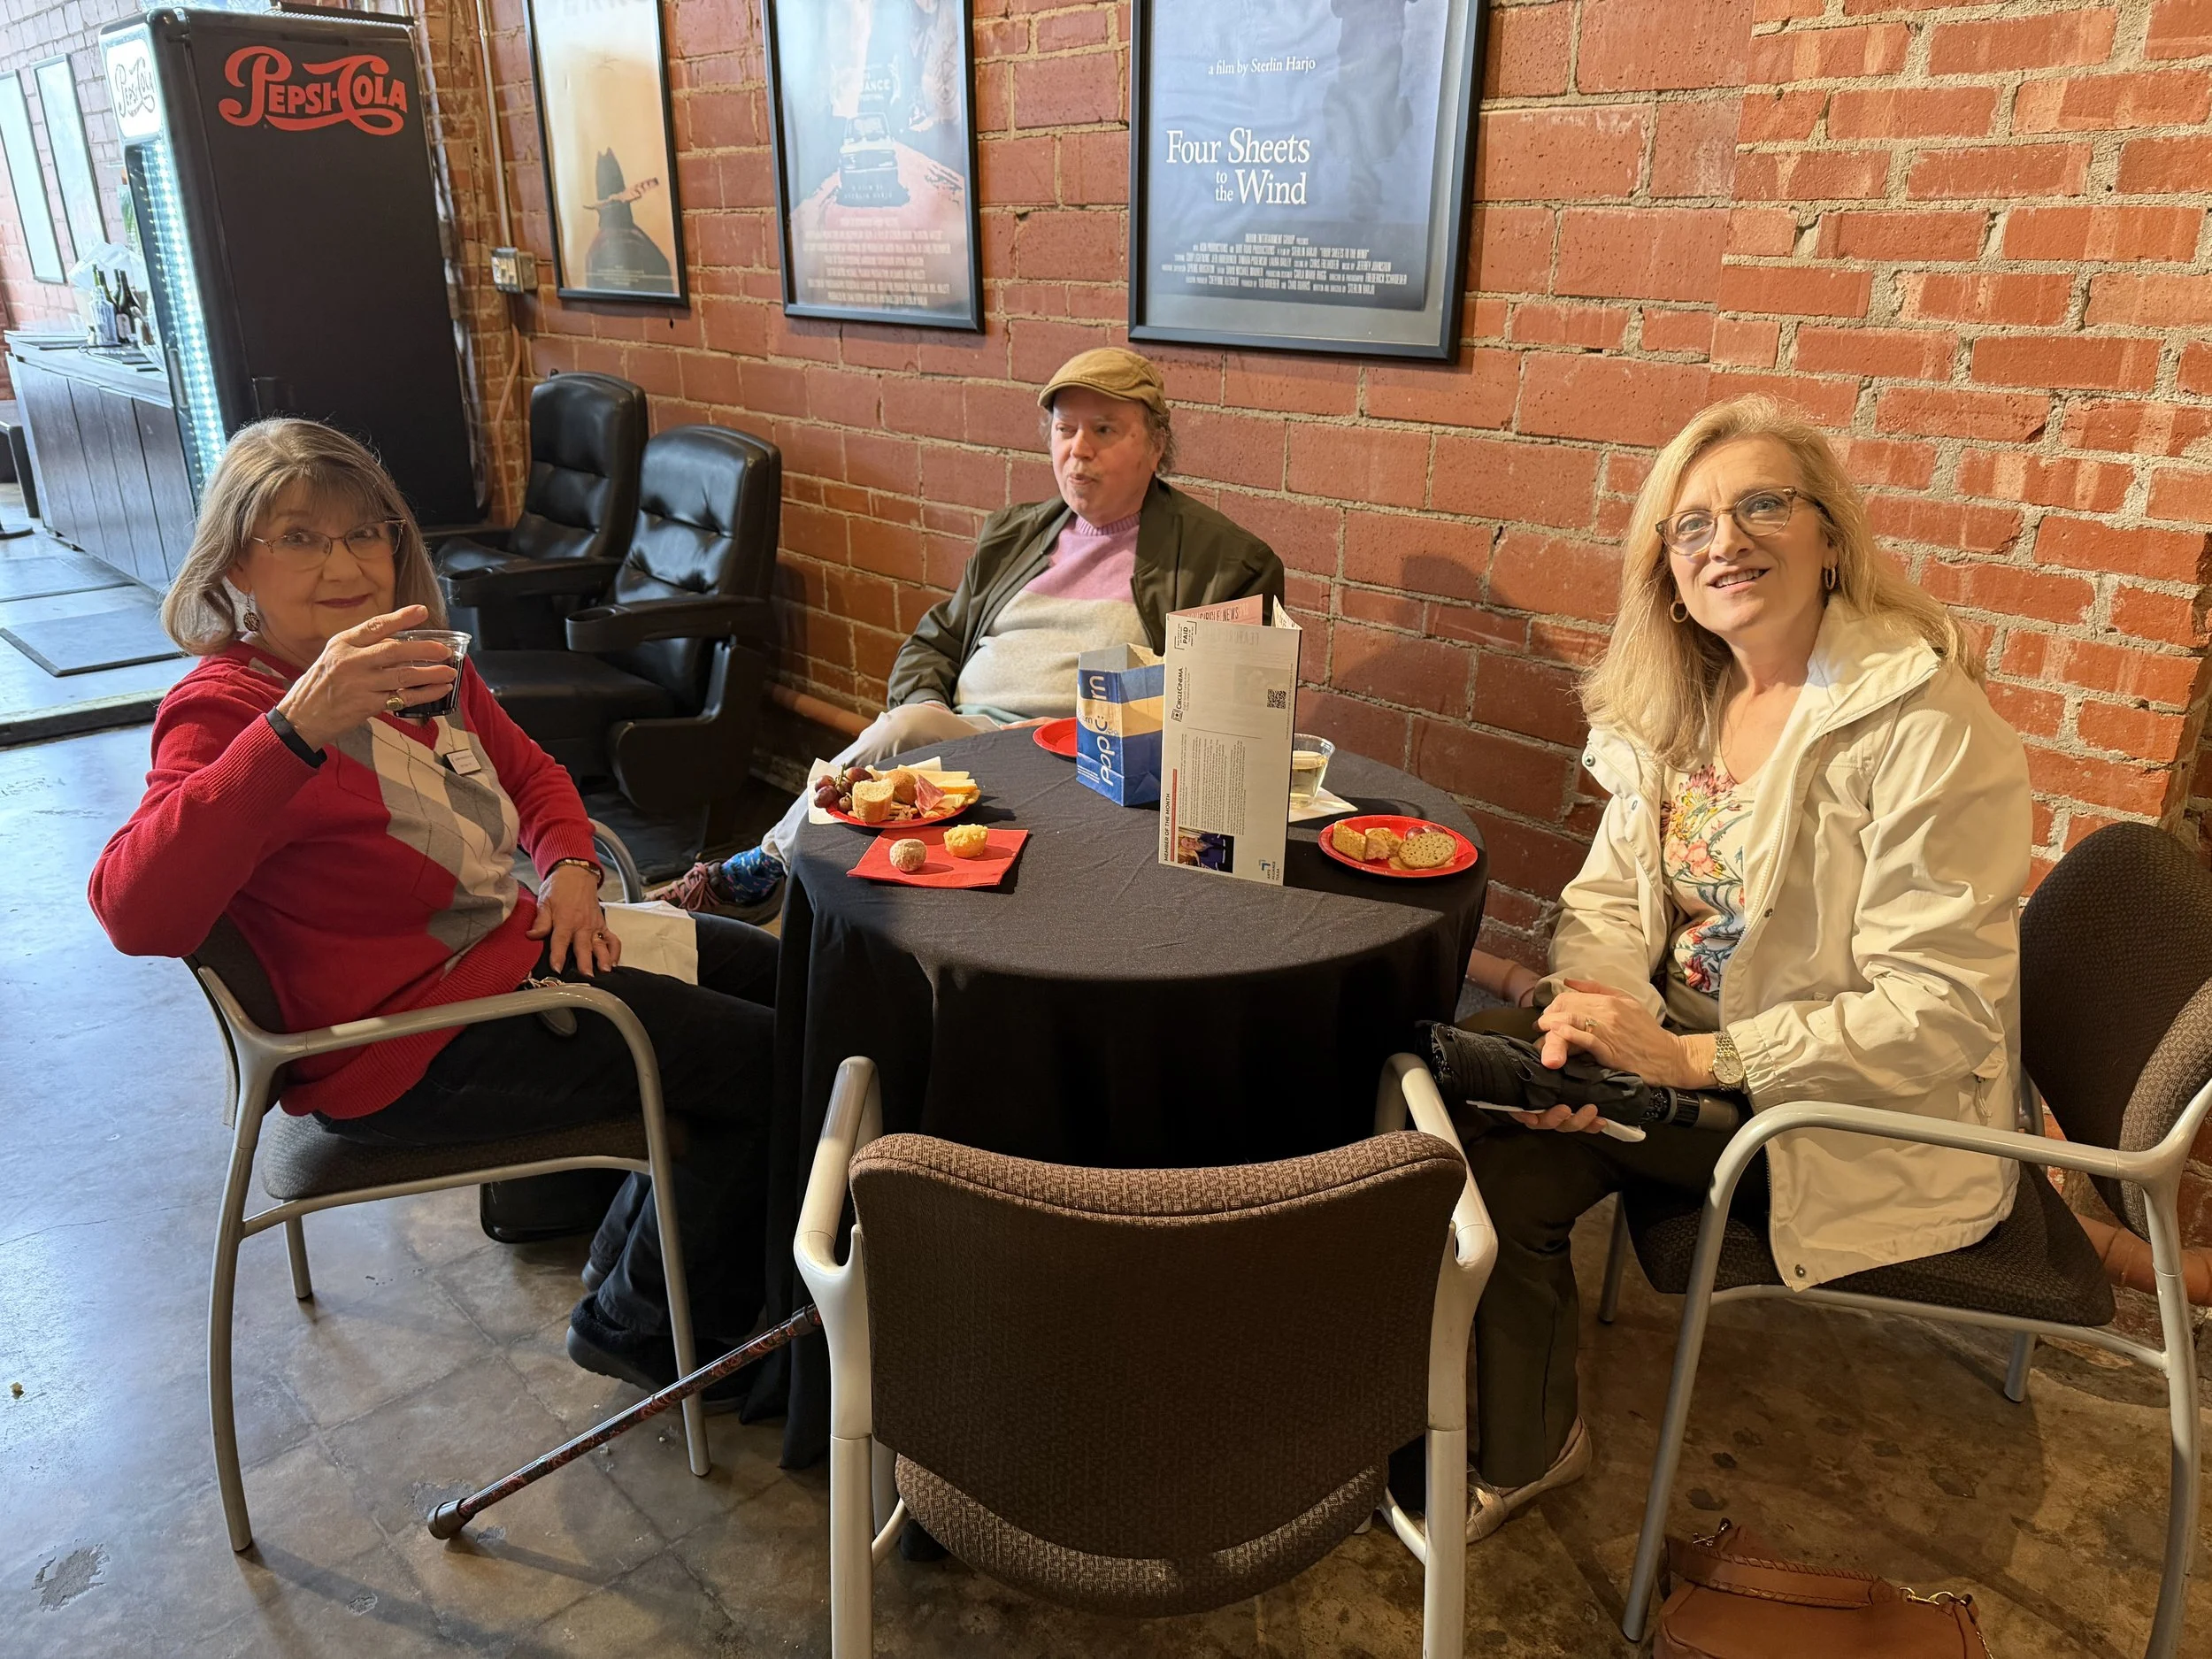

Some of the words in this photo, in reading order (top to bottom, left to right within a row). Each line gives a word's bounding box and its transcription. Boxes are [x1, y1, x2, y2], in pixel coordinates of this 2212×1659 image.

[1208, 65, 1213, 75] a
[1217, 59, 1234, 75] film
[1237, 58, 1248, 77] by
[1251, 57, 1282, 73] Sterlin
[1286, 56, 1316, 73] Harjo
[218, 45, 408, 136] PEPSI-COLA
[1166, 130, 1221, 164] Four
[1228, 127, 1310, 164] Sheets
[1216, 170, 1227, 184] to
[1216, 185, 1233, 202] the
[1234, 169, 1307, 205] Wind
